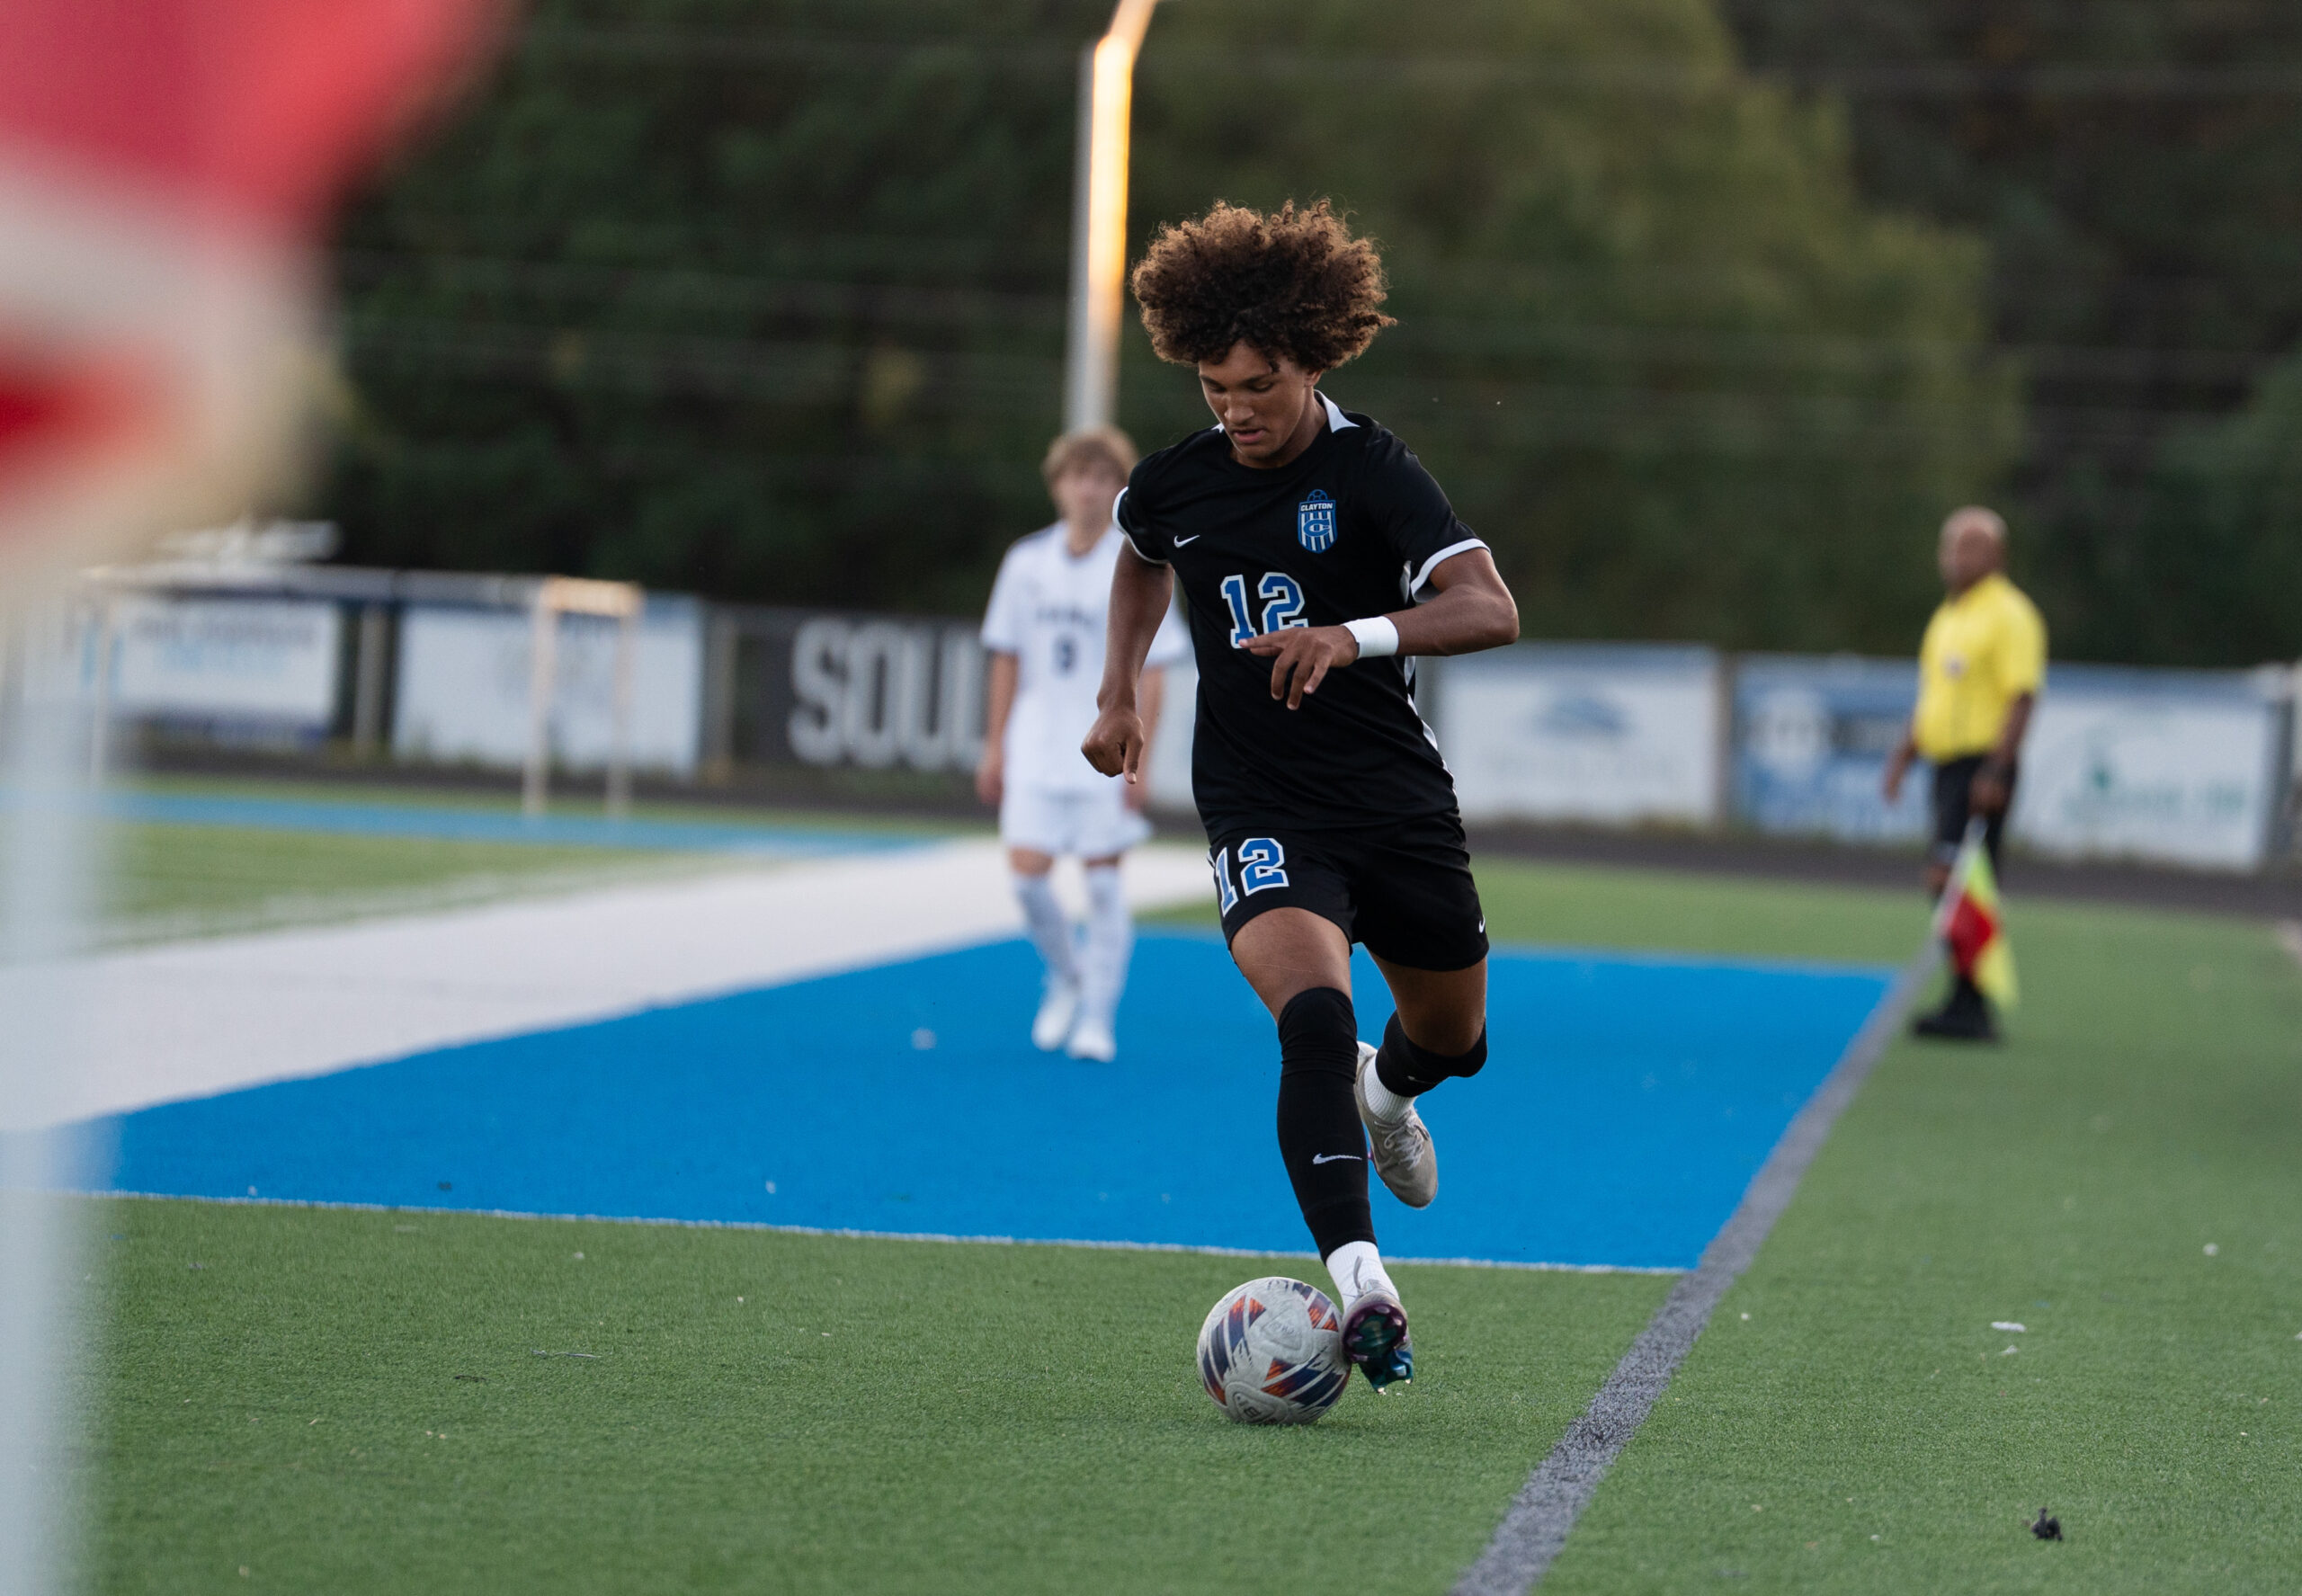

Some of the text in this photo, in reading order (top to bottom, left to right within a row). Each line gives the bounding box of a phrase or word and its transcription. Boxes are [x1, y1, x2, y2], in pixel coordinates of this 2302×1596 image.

[1300, 503, 1334, 512] CLAYTON
[1220, 572, 1309, 649] 12
[1216, 837, 1289, 918] 12
